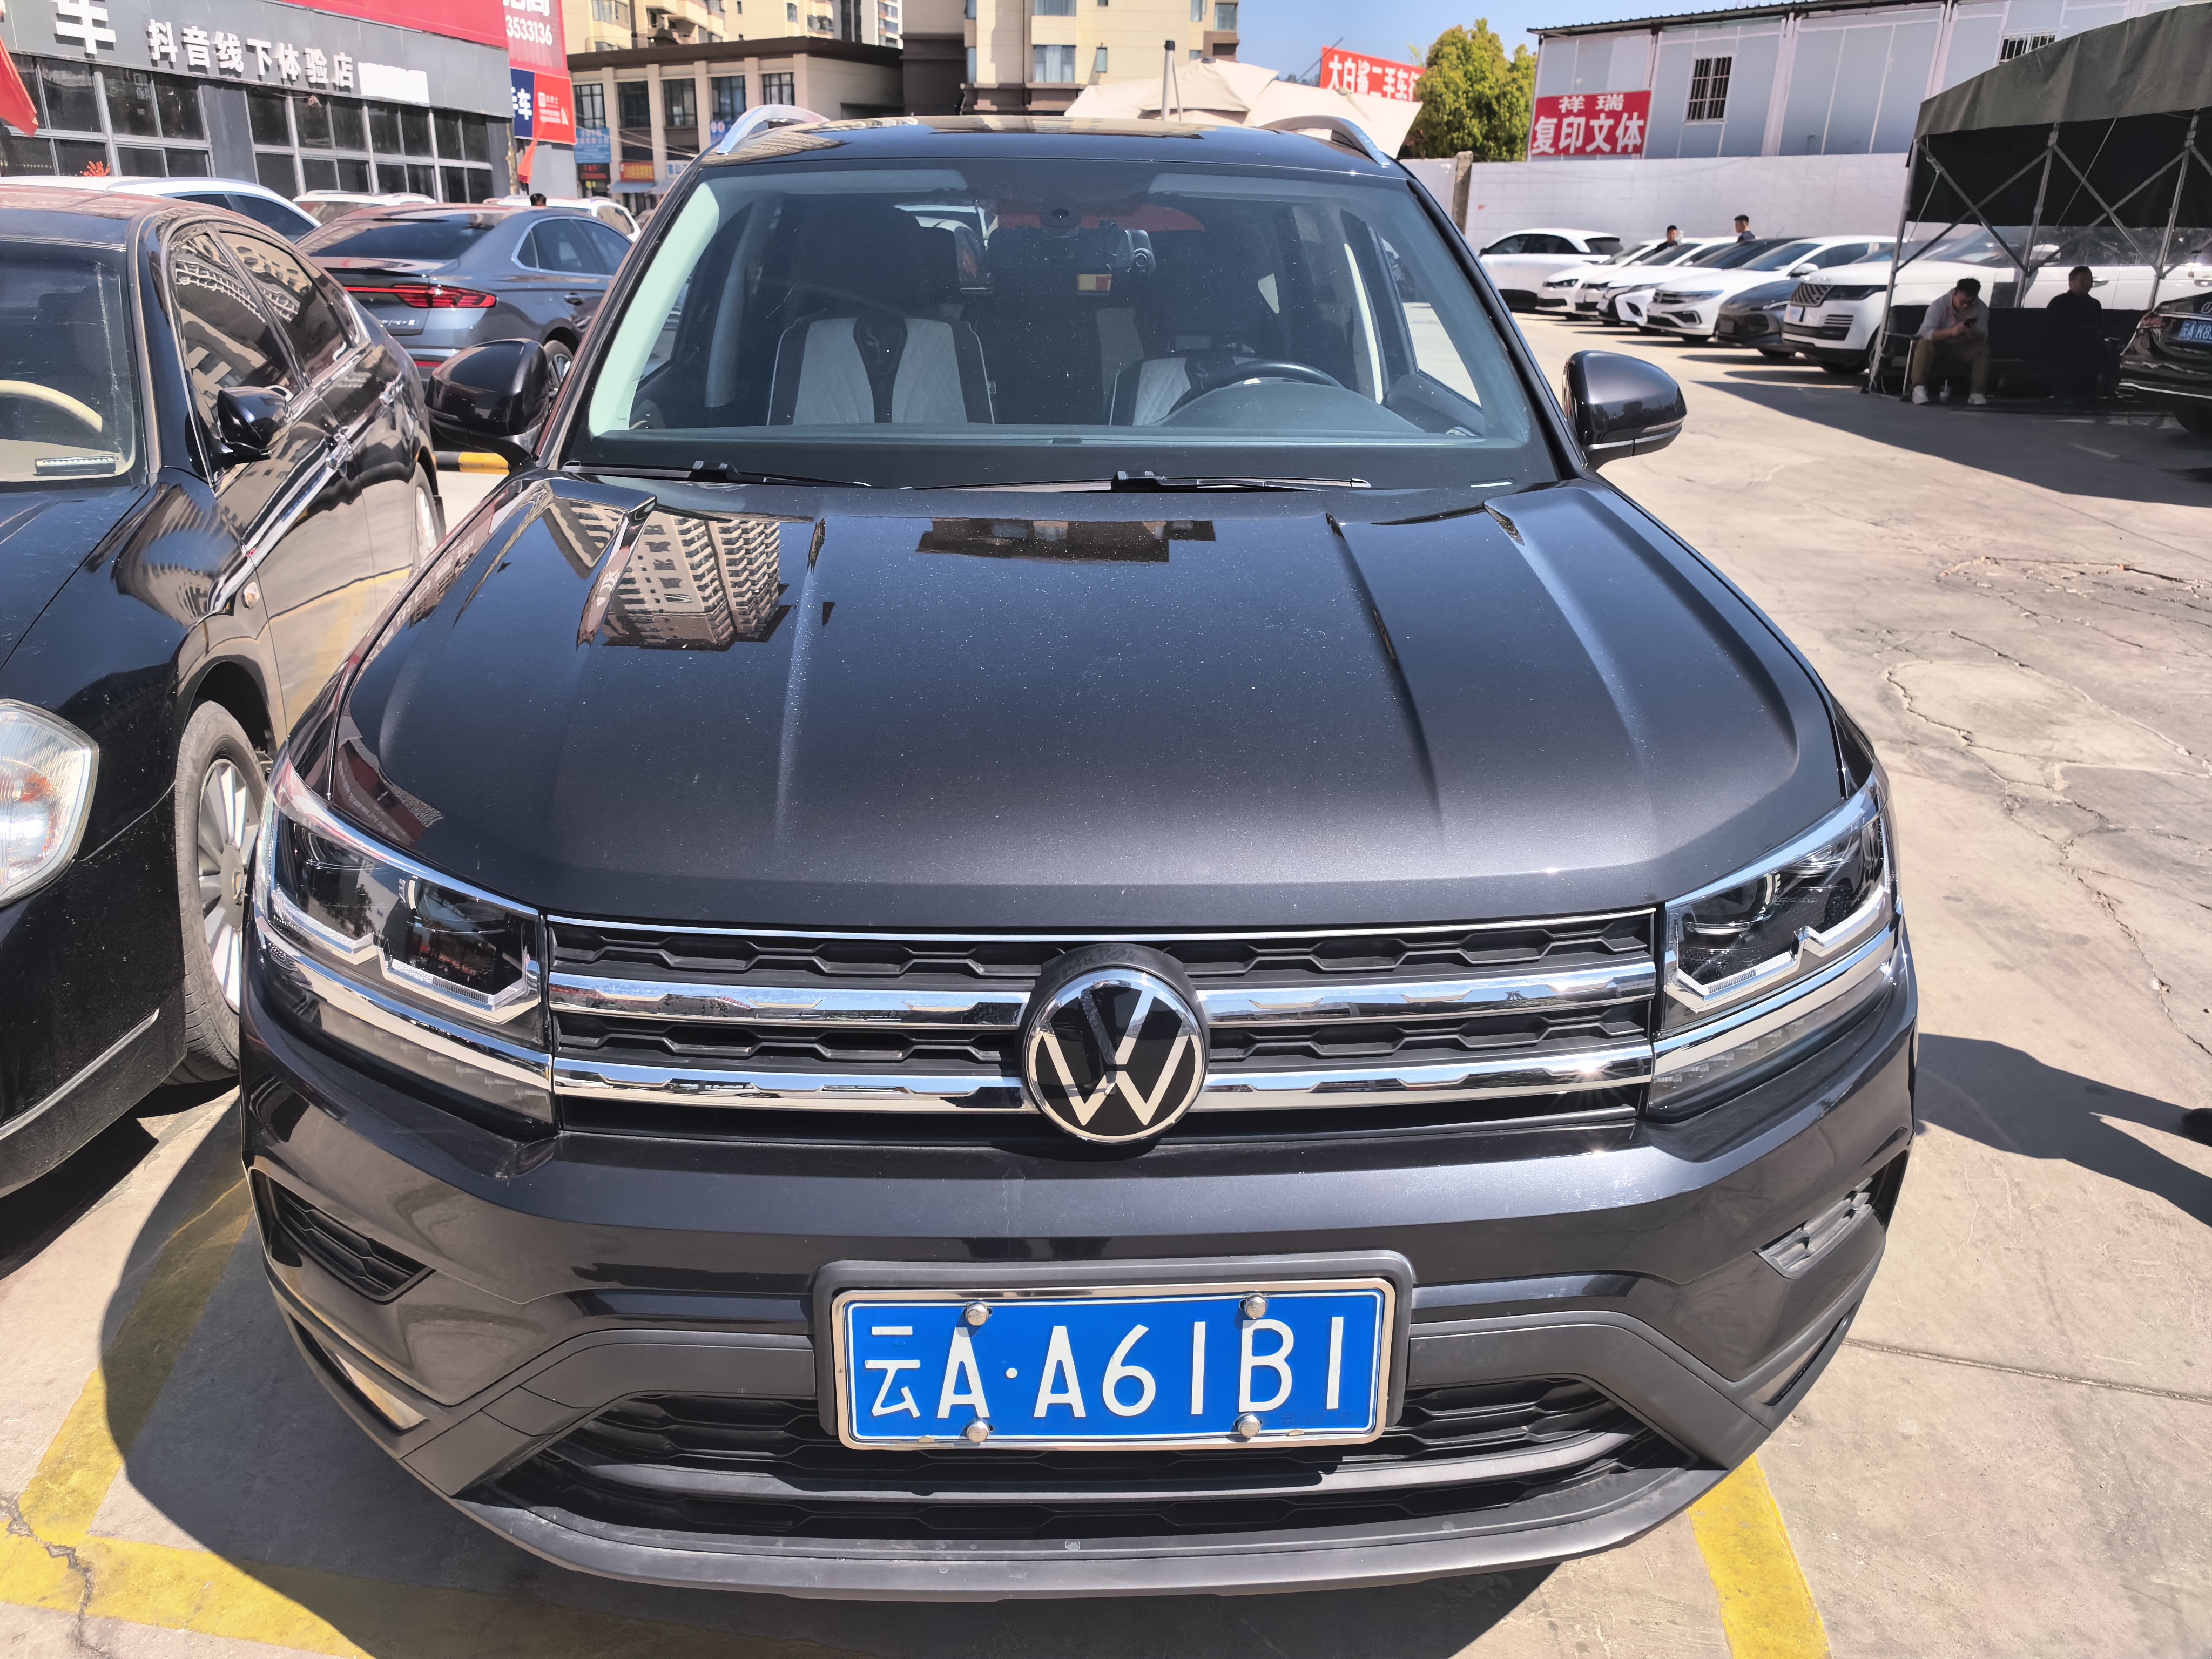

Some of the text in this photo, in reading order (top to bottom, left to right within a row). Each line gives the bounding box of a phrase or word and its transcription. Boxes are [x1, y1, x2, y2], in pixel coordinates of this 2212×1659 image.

[505, 15, 552, 45] 3533136
[147, 19, 354, 88] 抖音线下体验店
[1531, 112, 1644, 154] 复印文体
